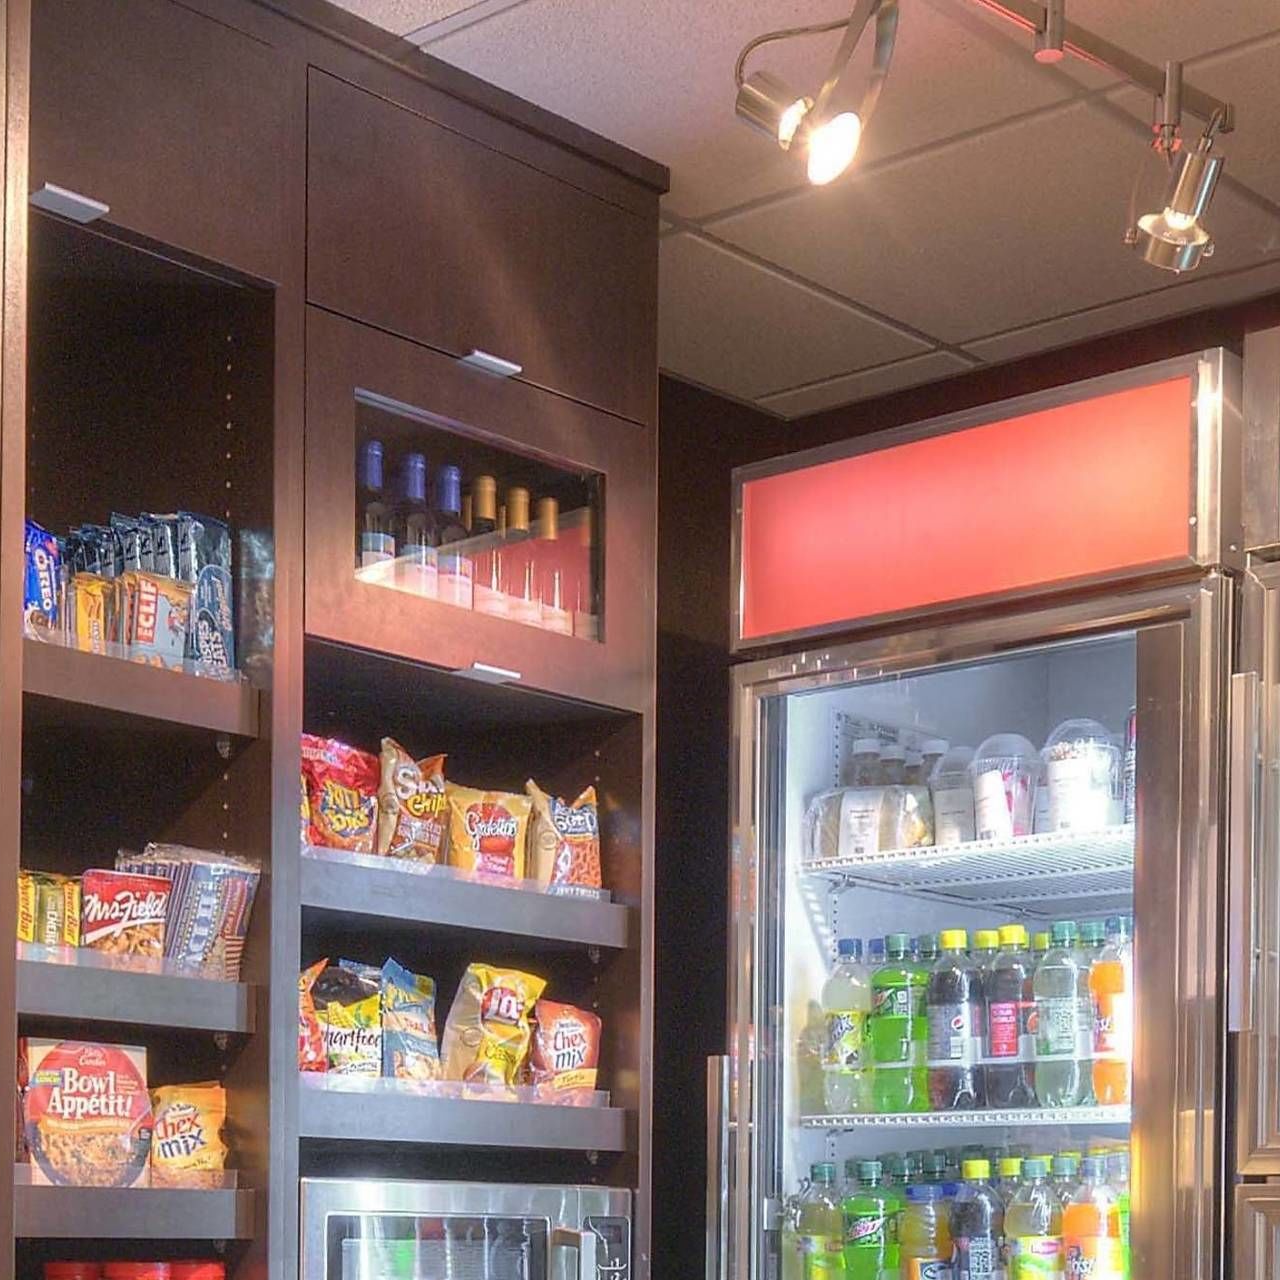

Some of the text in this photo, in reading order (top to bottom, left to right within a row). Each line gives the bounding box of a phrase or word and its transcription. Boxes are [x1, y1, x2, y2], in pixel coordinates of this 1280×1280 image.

[35, 549, 52, 610] OREO
[554, 1030, 586, 1051] Chex
[554, 1046, 587, 1069] mix
[61, 1067, 117, 1094] Bowl
[46, 1086, 133, 1120] Appétit!
[156, 1112, 201, 1140] Chex
[160, 1128, 208, 1159] mix
